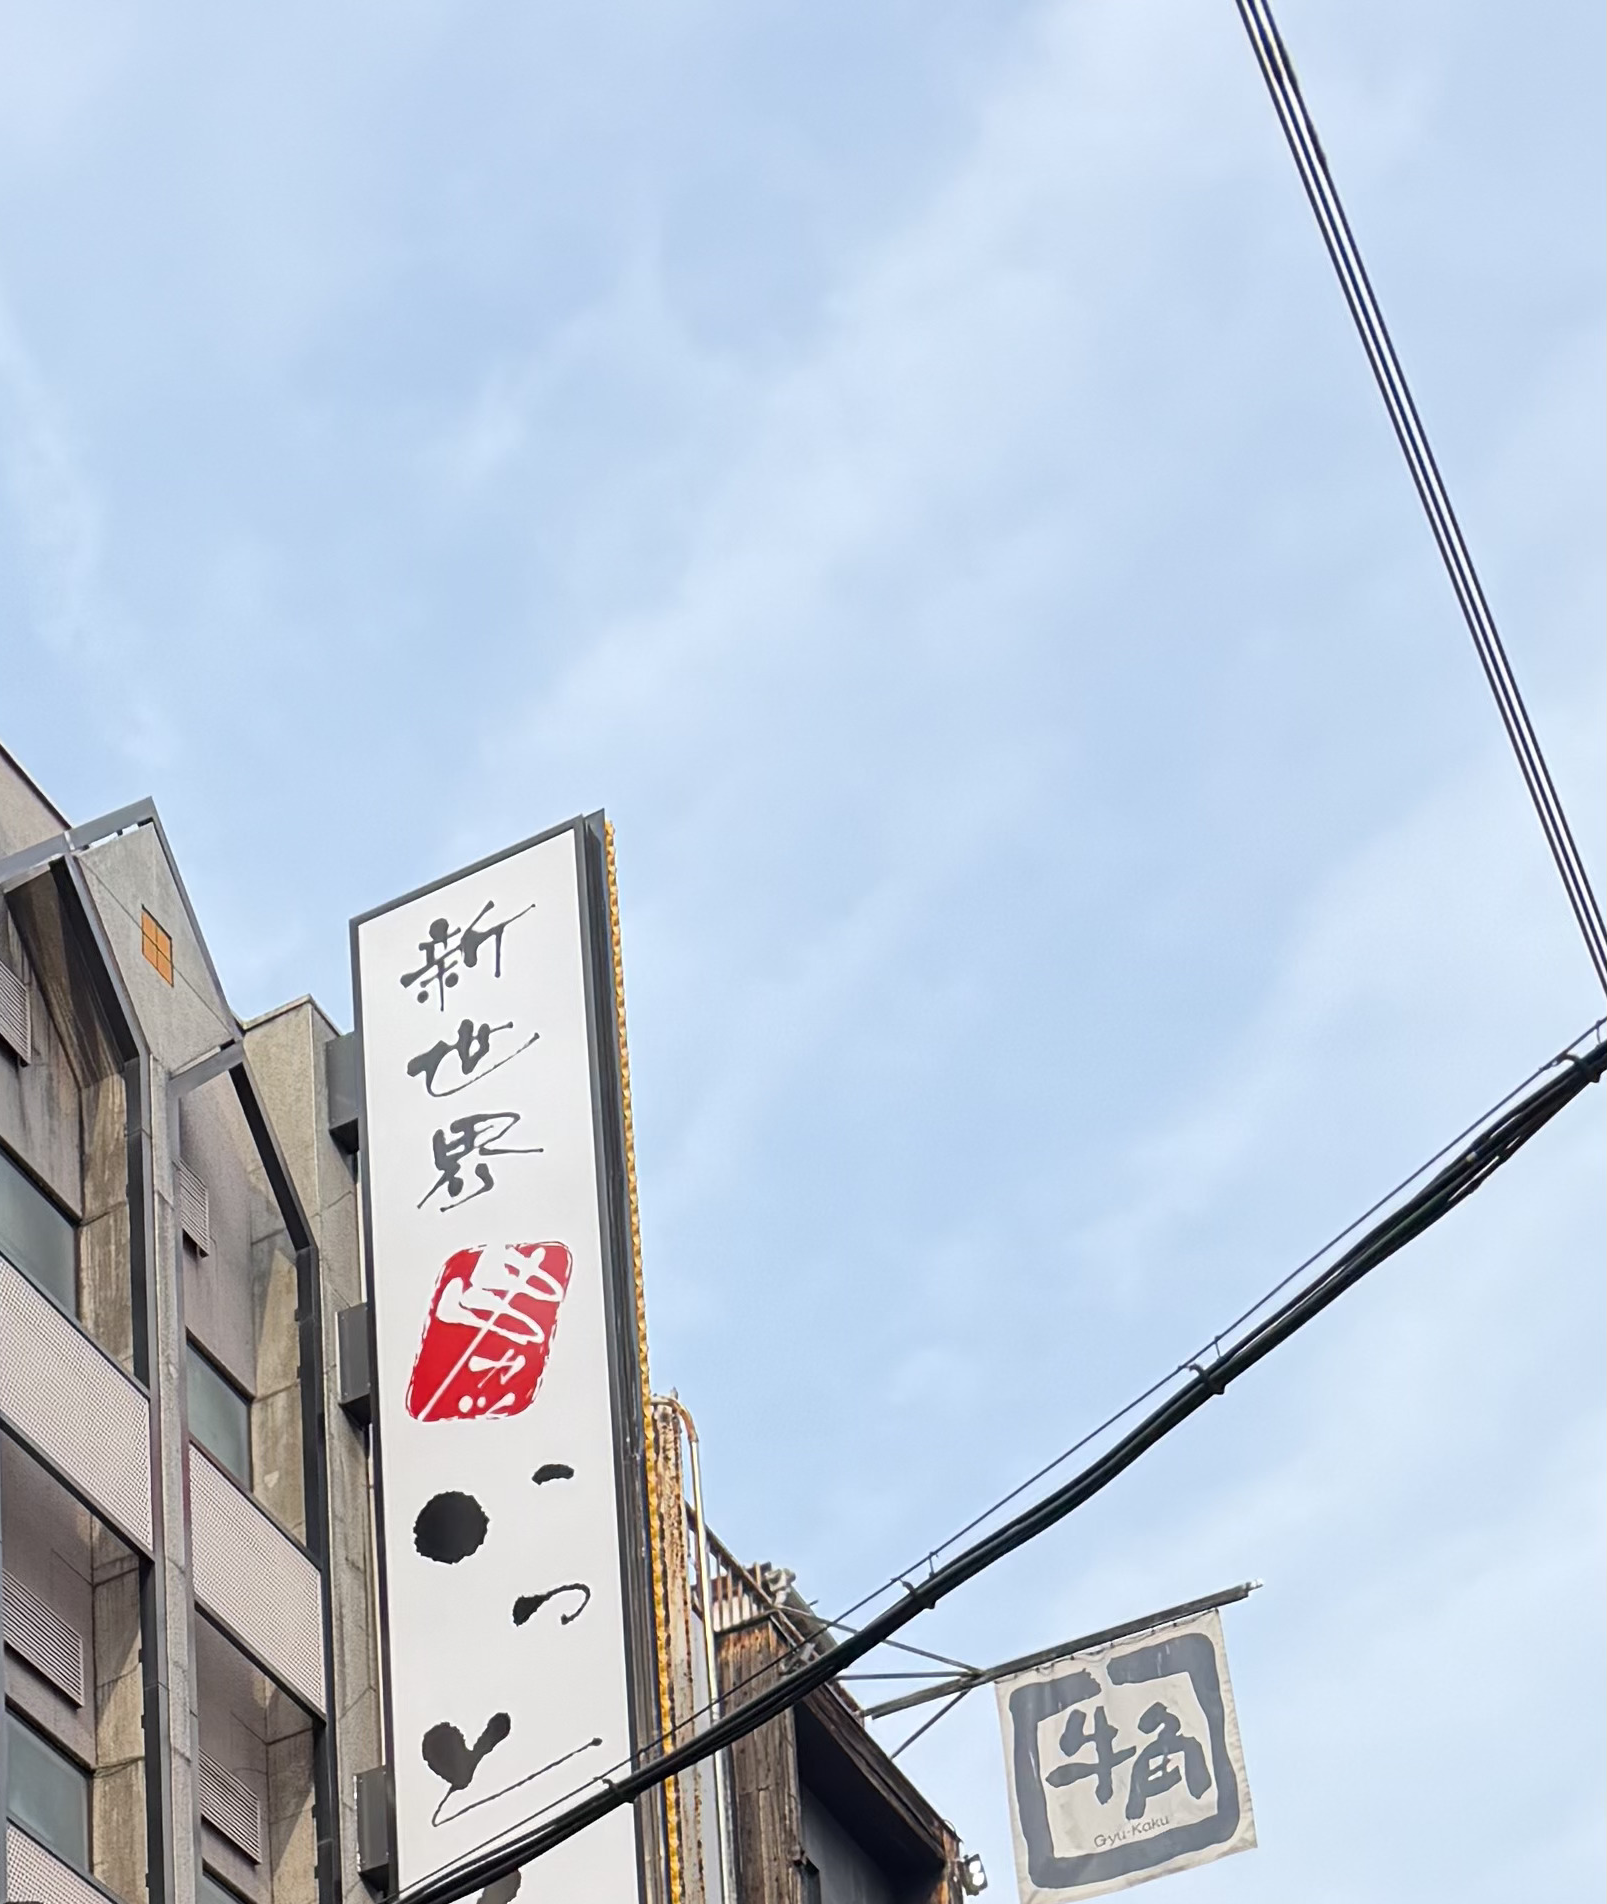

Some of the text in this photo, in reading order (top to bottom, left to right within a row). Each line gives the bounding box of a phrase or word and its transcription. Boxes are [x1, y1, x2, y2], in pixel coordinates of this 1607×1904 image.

[400, 899, 546, 1212] 新世界
[1045, 1701, 1213, 1821] 牛角
[1093, 1814, 1171, 1849] Gyu-Kaku
